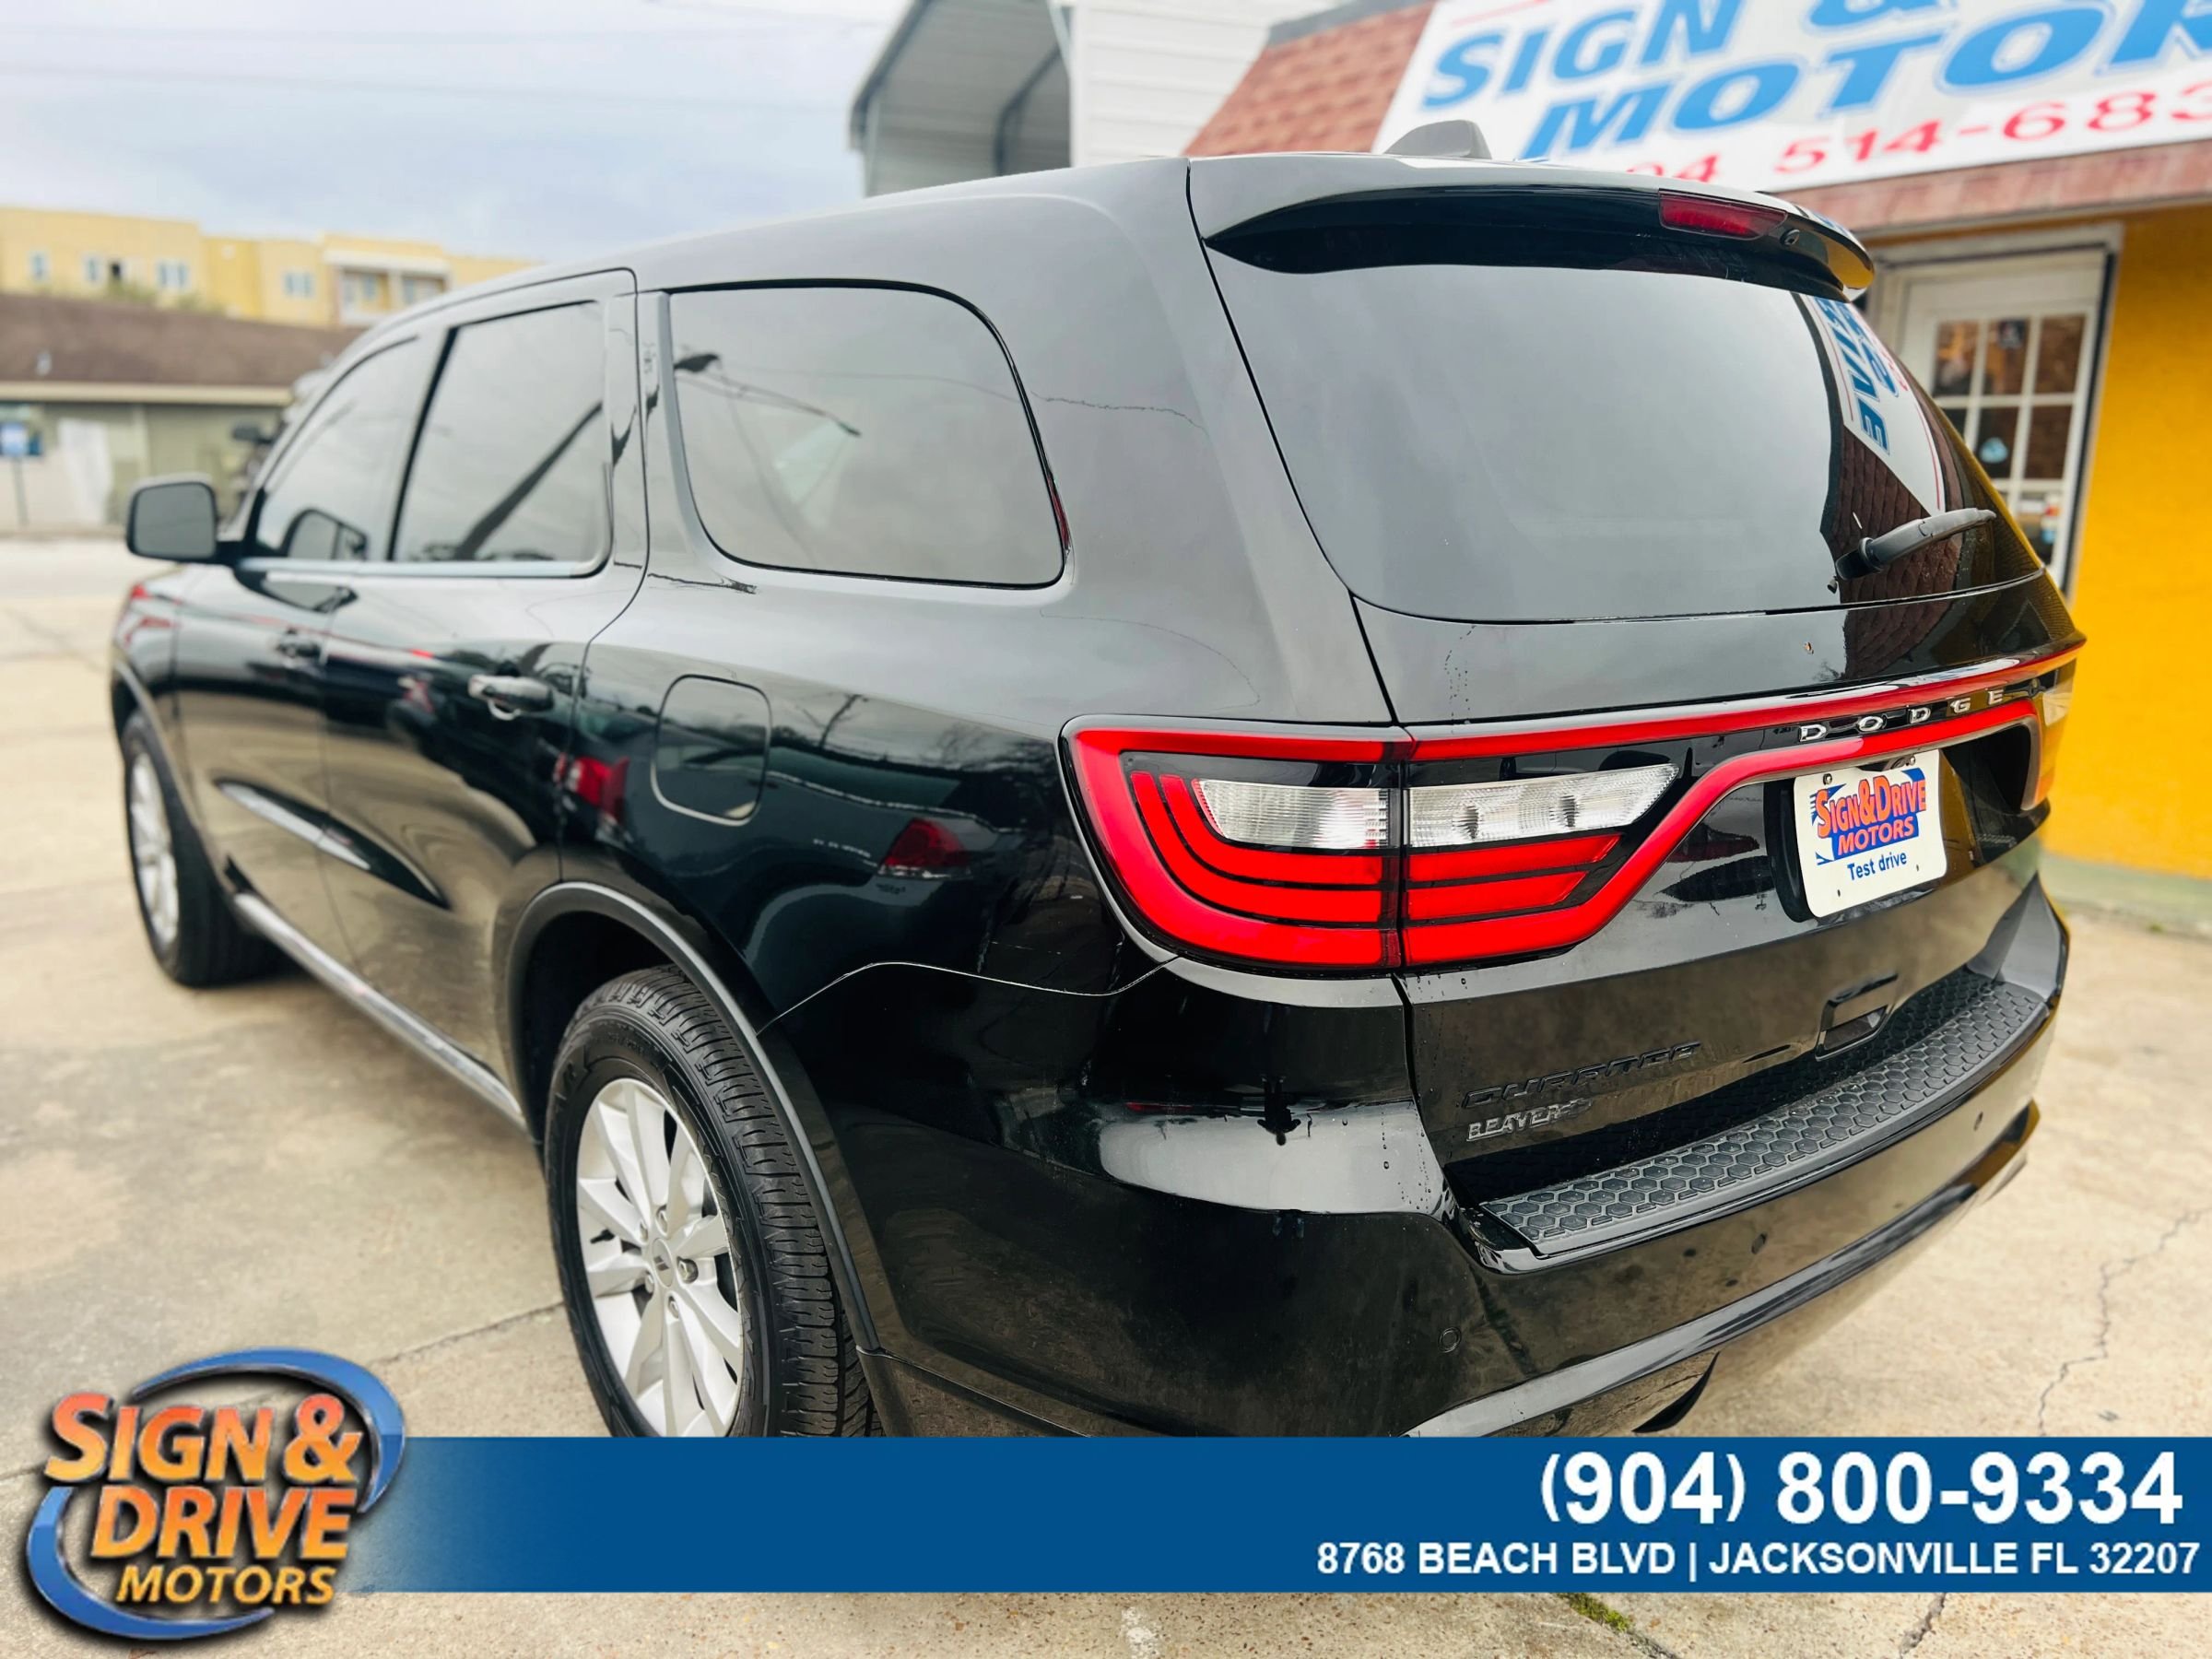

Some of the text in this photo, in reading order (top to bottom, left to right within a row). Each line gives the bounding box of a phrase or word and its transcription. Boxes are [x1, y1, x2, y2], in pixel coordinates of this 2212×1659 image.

[1422, 0, 1742, 109] SIGN
[1799, 688, 2005, 742] DODGE
[1838, 817, 1914, 855] MOTORS
[1847, 852, 1908, 880] Test drive
